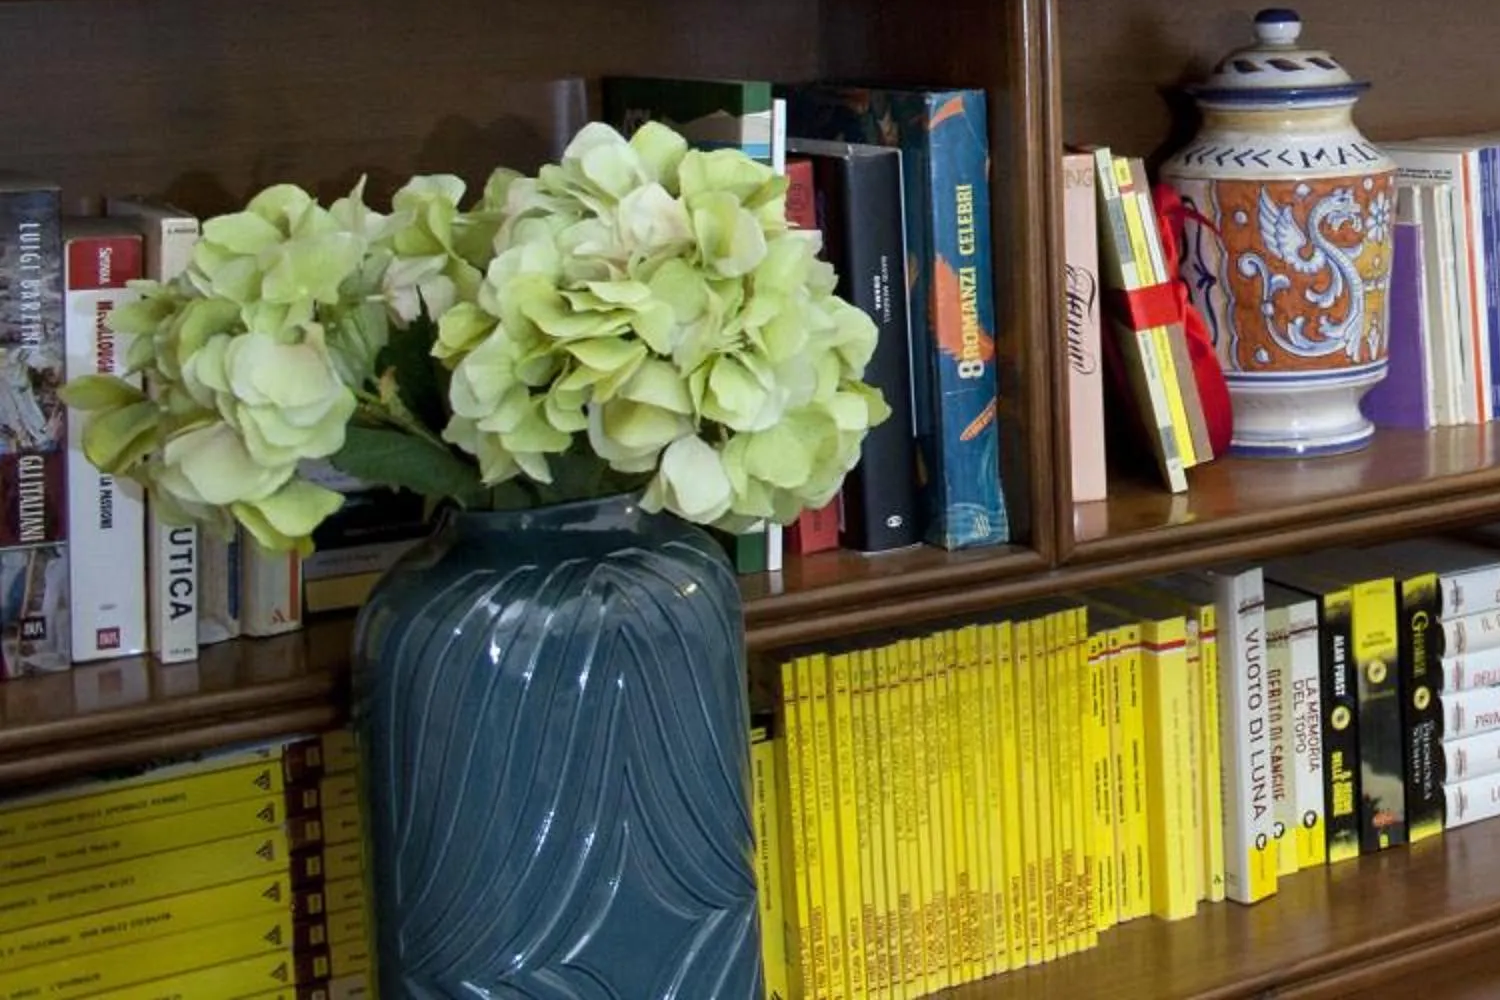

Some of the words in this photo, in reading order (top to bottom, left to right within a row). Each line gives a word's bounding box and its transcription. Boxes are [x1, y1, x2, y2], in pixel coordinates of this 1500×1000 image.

[957, 185, 975, 255] CELEBRI
[18, 222, 42, 269] LUIGI
[874, 275, 882, 310] OBAMA
[19, 279, 46, 352] BARZINI
[957, 267, 983, 360] ROMANZI
[957, 360, 987, 379] 8
[18, 456, 46, 480] GLI
[99, 476, 113, 488] LA
[18, 481, 48, 542] ITALIANI
[99, 489, 114, 529] PASSIONE
[1480, 616, 1493, 632] IL
[1333, 635, 1344, 662] ALAN
[1245, 628, 1265, 710] VUOTO
[1306, 676, 1317, 697] LA
[1334, 665, 1346, 697] FURST
[1266, 669, 1282, 724] DEBITO
[1294, 680, 1305, 711] DEL
[1248, 718, 1264, 743] DI
[1269, 726, 1283, 741] DI
[1294, 716, 1307, 755] TOPO
[1307, 701, 1320, 773] MEMORIA
[1250, 750, 1268, 820] LUNA
[1271, 746, 1285, 801] SANGUE
